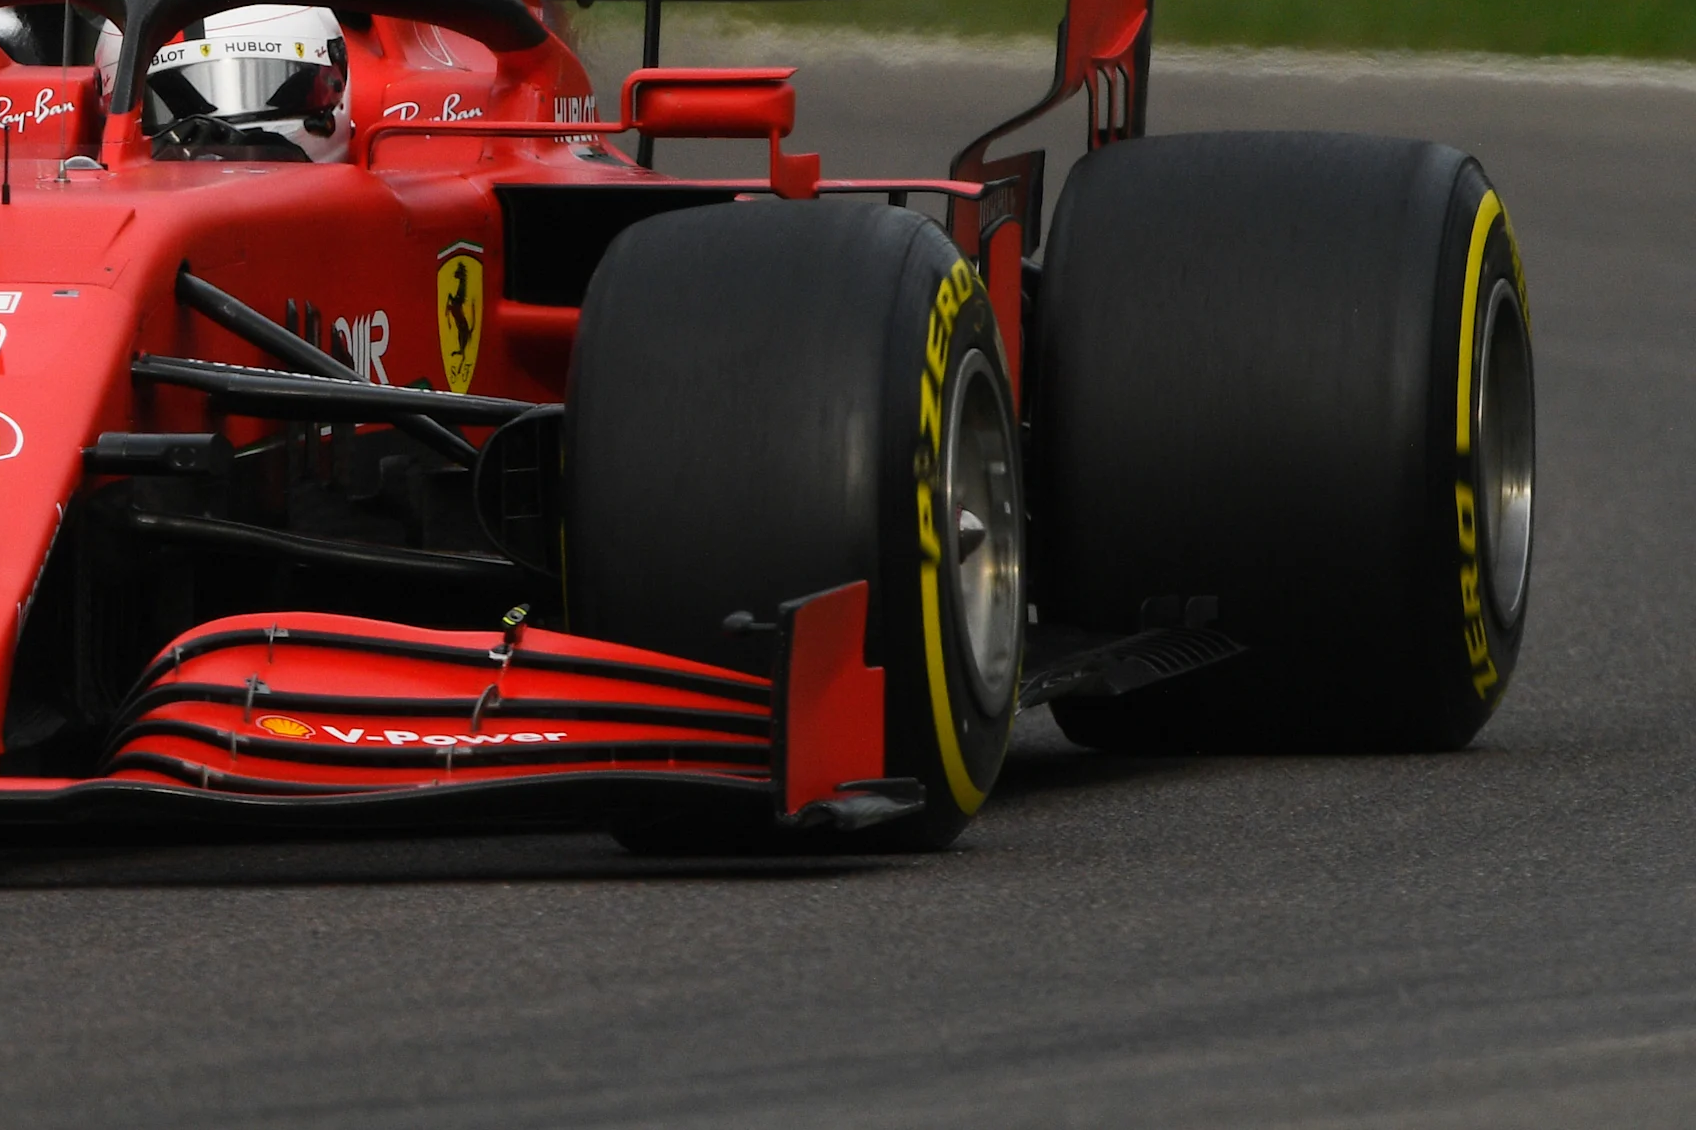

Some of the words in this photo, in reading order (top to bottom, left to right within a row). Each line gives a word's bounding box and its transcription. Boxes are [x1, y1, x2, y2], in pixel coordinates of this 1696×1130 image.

[225, 42, 282, 54] HUBLOT
[152, 49, 185, 67] BLOT
[320, 726, 568, 746] V-Power
